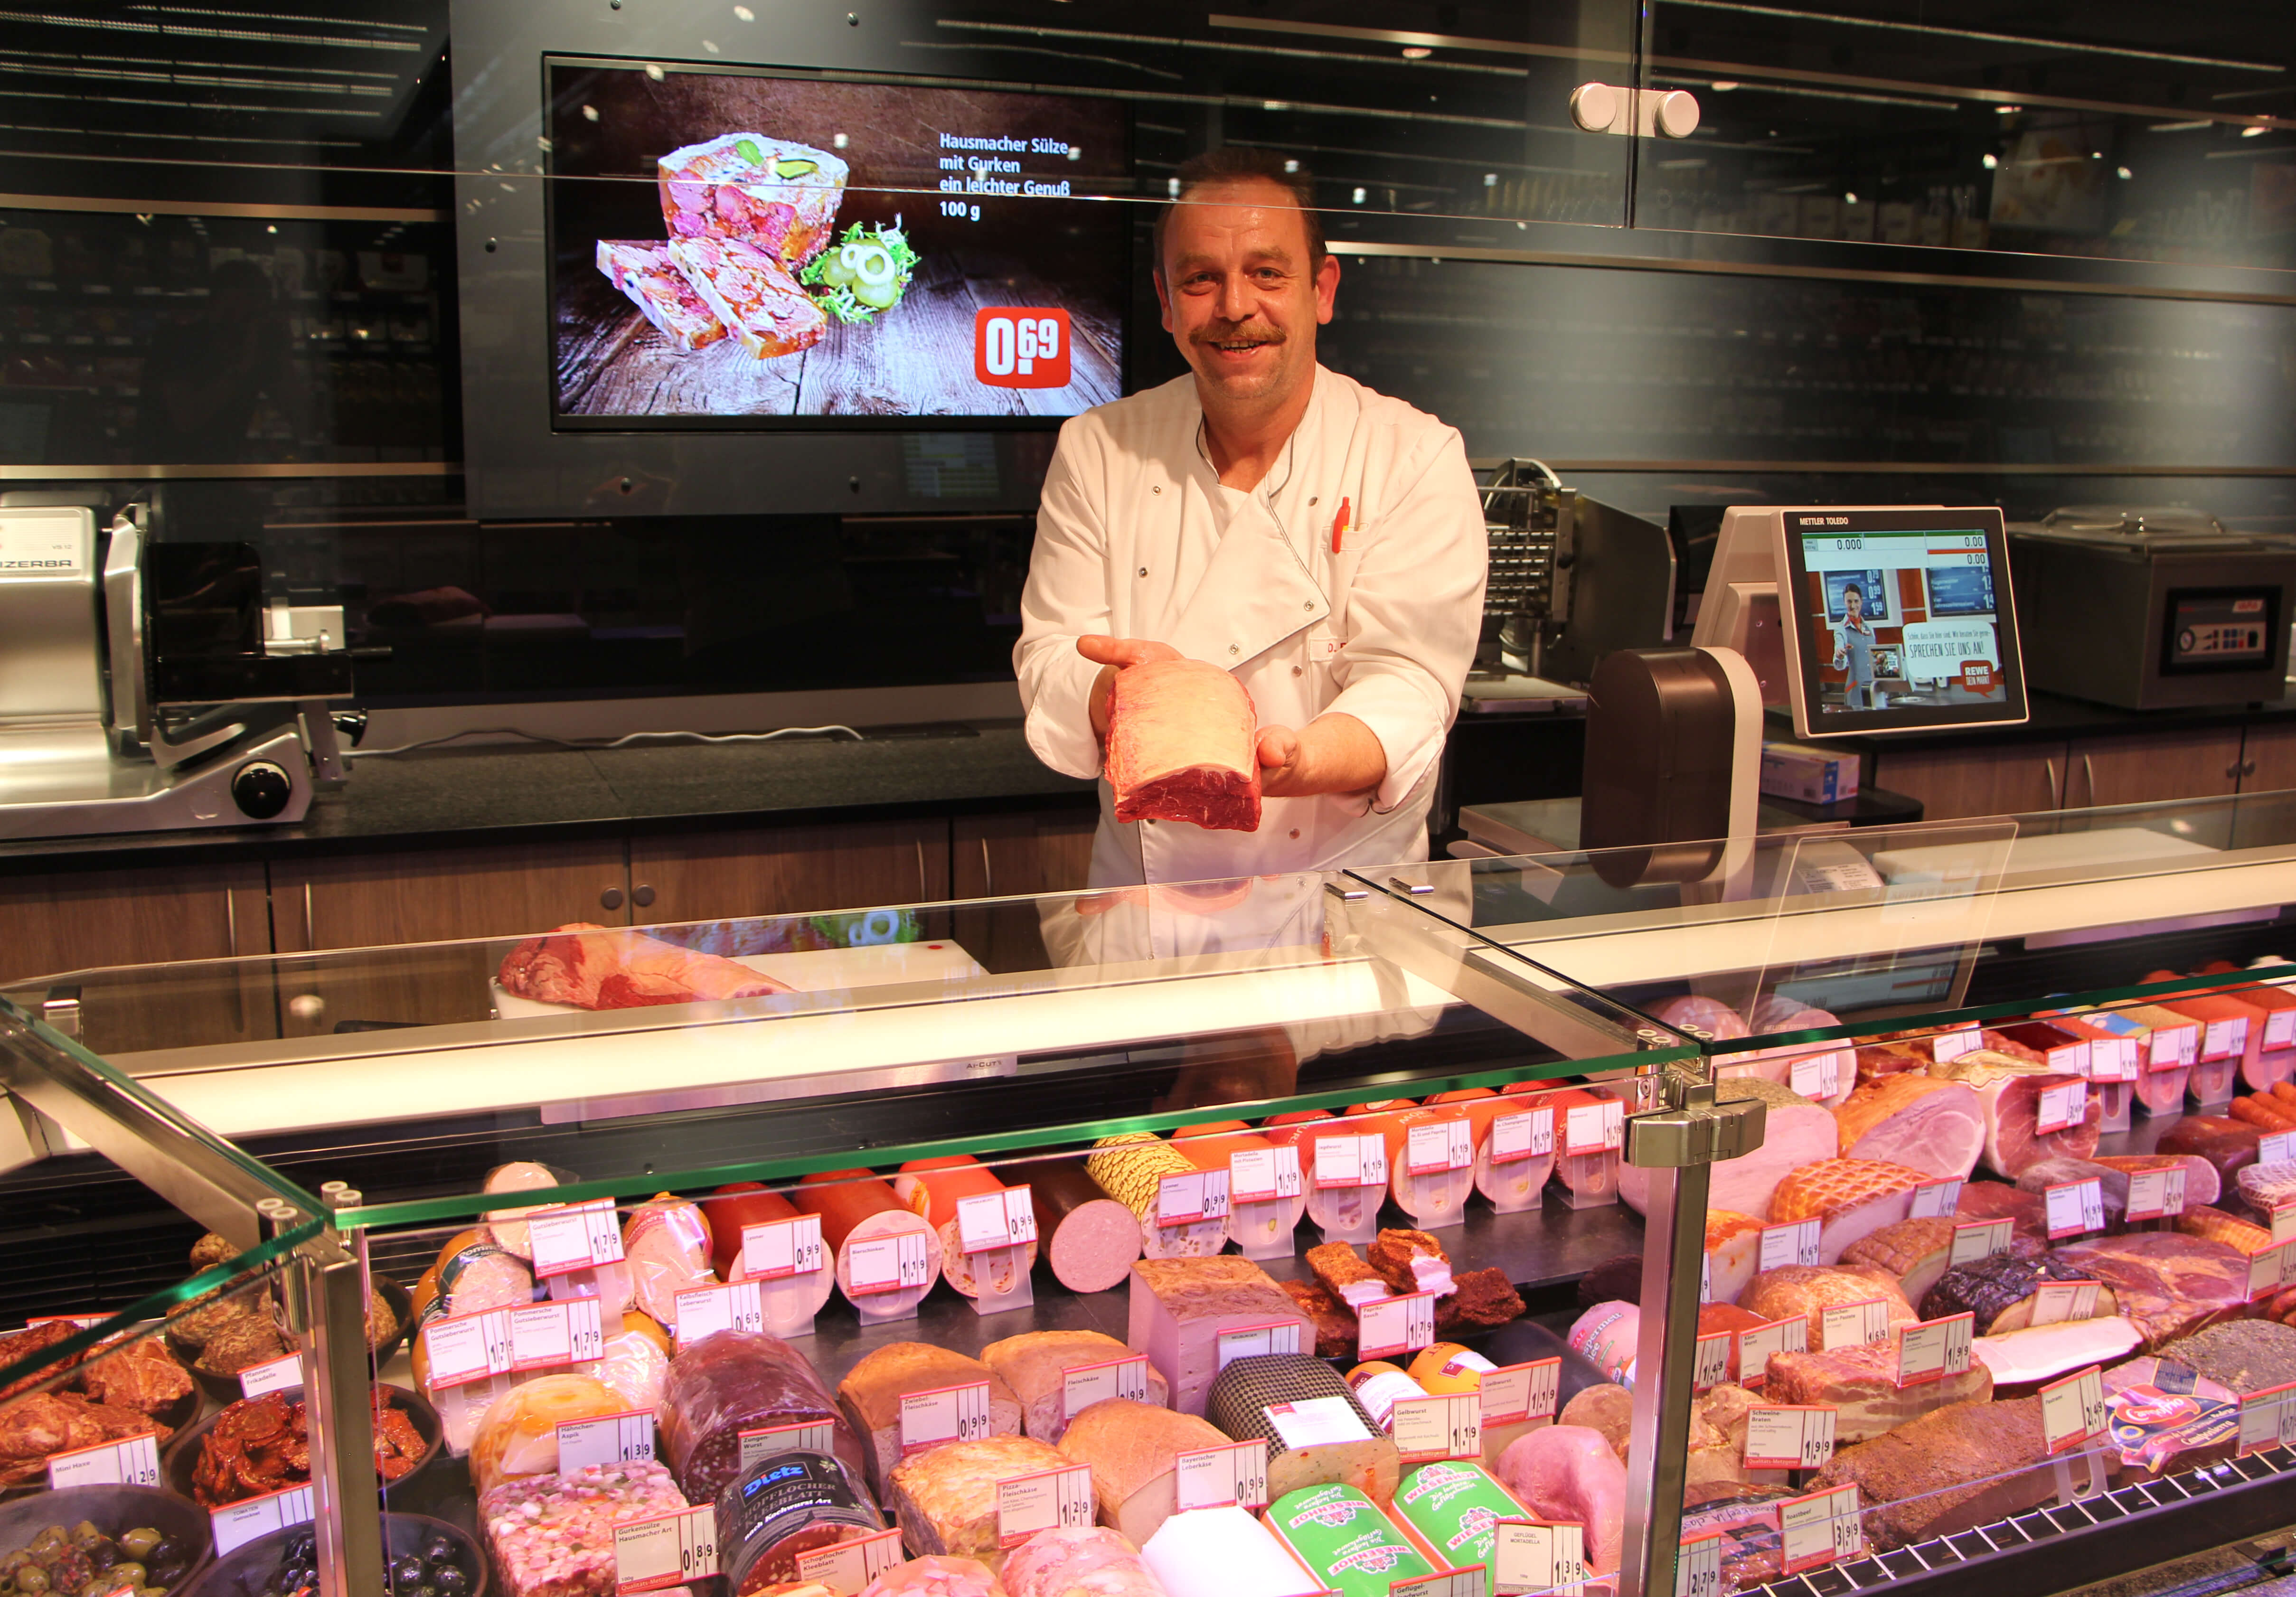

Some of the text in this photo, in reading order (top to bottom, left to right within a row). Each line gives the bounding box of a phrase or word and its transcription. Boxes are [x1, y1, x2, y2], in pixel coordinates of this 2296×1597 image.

[940, 132, 1068, 155] Hausmacher Sülze
[940, 154, 1020, 173] mit Gurken
[940, 176, 1070, 197] ein leichter Genuß
[940, 201, 980, 221] 100 g
[986, 318, 1058, 375] 0.69
[1836, 539, 1862, 550] 0.000
[1964, 536, 1984, 547] 0.00
[1967, 554, 1985, 564] 0.00
[1909, 641, 1984, 658] SPRECHEN SIE UNS AN!
[1965, 666, 1989, 676] REWE
[1966, 676, 1990, 686] DEIN MARKT
[1534, 1131, 1550, 1148] 1.19
[1451, 1144, 1468, 1160] 1.19
[1363, 1160, 1382, 1177] 1.19
[1278, 1173, 1297, 1189] 1.19
[1204, 1194, 1225, 1212] 0.99
[532, 1217, 577, 1230] Gutsleberwurst
[1011, 1215, 1032, 1234] 0.99
[593, 1233, 617, 1255] 1.79
[852, 1246, 885, 1255] Bierschinken
[797, 1244, 819, 1265] 0.99
[1801, 1244, 1818, 1263] 1.69
[902, 1260, 924, 1278] 1.19
[679, 1290, 714, 1300] Kalbsfleisch-
[679, 1298, 711, 1307] Leberwurst
[514, 1307, 552, 1318] Pommersche
[1363, 1305, 1384, 1314] Paprika-
[430, 1321, 467, 1334] Pommersche
[514, 1313, 560, 1325] Gutsleberwurst
[735, 1312, 760, 1332] 0.69
[431, 1326, 475, 1341] Gutsleberwurst
[1409, 1321, 1432, 1342] 1.79
[573, 1331, 599, 1353] 1.79
[1948, 1345, 1969, 1366] 1.99
[245, 1367, 272, 1379] Pfannen-
[246, 1372, 277, 1385] Frikadelle
[1703, 1361, 1723, 1381] 1.49
[1067, 1375, 1099, 1386] Fleischkäse
[1485, 1379, 1512, 1387] Gelbwurst
[904, 1395, 930, 1405] Zwiebel-
[904, 1400, 939, 1411] Fleischkäse
[1532, 1389, 1554, 1409] 1.19
[2086, 1401, 2103, 1427] 2.49
[561, 1424, 596, 1433] Hähnchen-
[960, 1414, 987, 1437] 0.99
[743, 1435, 770, 1443] Zungen-
[1453, 1427, 1476, 1447] 1.19
[1806, 1440, 1830, 1459] 1.99
[55, 1461, 91, 1473] Mini Haxe
[1182, 1453, 1216, 1464] Bayerischer
[1182, 1461, 1212, 1471] Leberkäse
[743, 1466, 804, 1497] Dietz
[1237, 1476, 1264, 1500] 0.99
[1407, 1472, 1476, 1500] WIESENHOF
[1003, 1487, 1037, 1498] Fleischkäse
[233, 1505, 259, 1516] TOMATEN
[765, 1499, 814, 1523] Kochwurst
[1063, 1501, 1088, 1524] 1.29
[1292, 1501, 1367, 1526] WIESENHOF
[1786, 1508, 1812, 1519] Roastbeef
[619, 1522, 660, 1535] Gurkensülze
[619, 1530, 660, 1542] Hausmacher
[1836, 1523, 1858, 1546] 3.99
[683, 1544, 712, 1571] 0.89
[803, 1549, 849, 1565] Schopflocher-
[803, 1559, 834, 1571] Kleeblatt
[1331, 1546, 1407, 1574] WIESENHOF
[1555, 1560, 1581, 1583] 1.39
[621, 1574, 679, 1591] Qualitäts-Metzgerei
[1397, 1584, 1425, 1594] Geflügel-
[1691, 1570, 1716, 1594] 2.79
